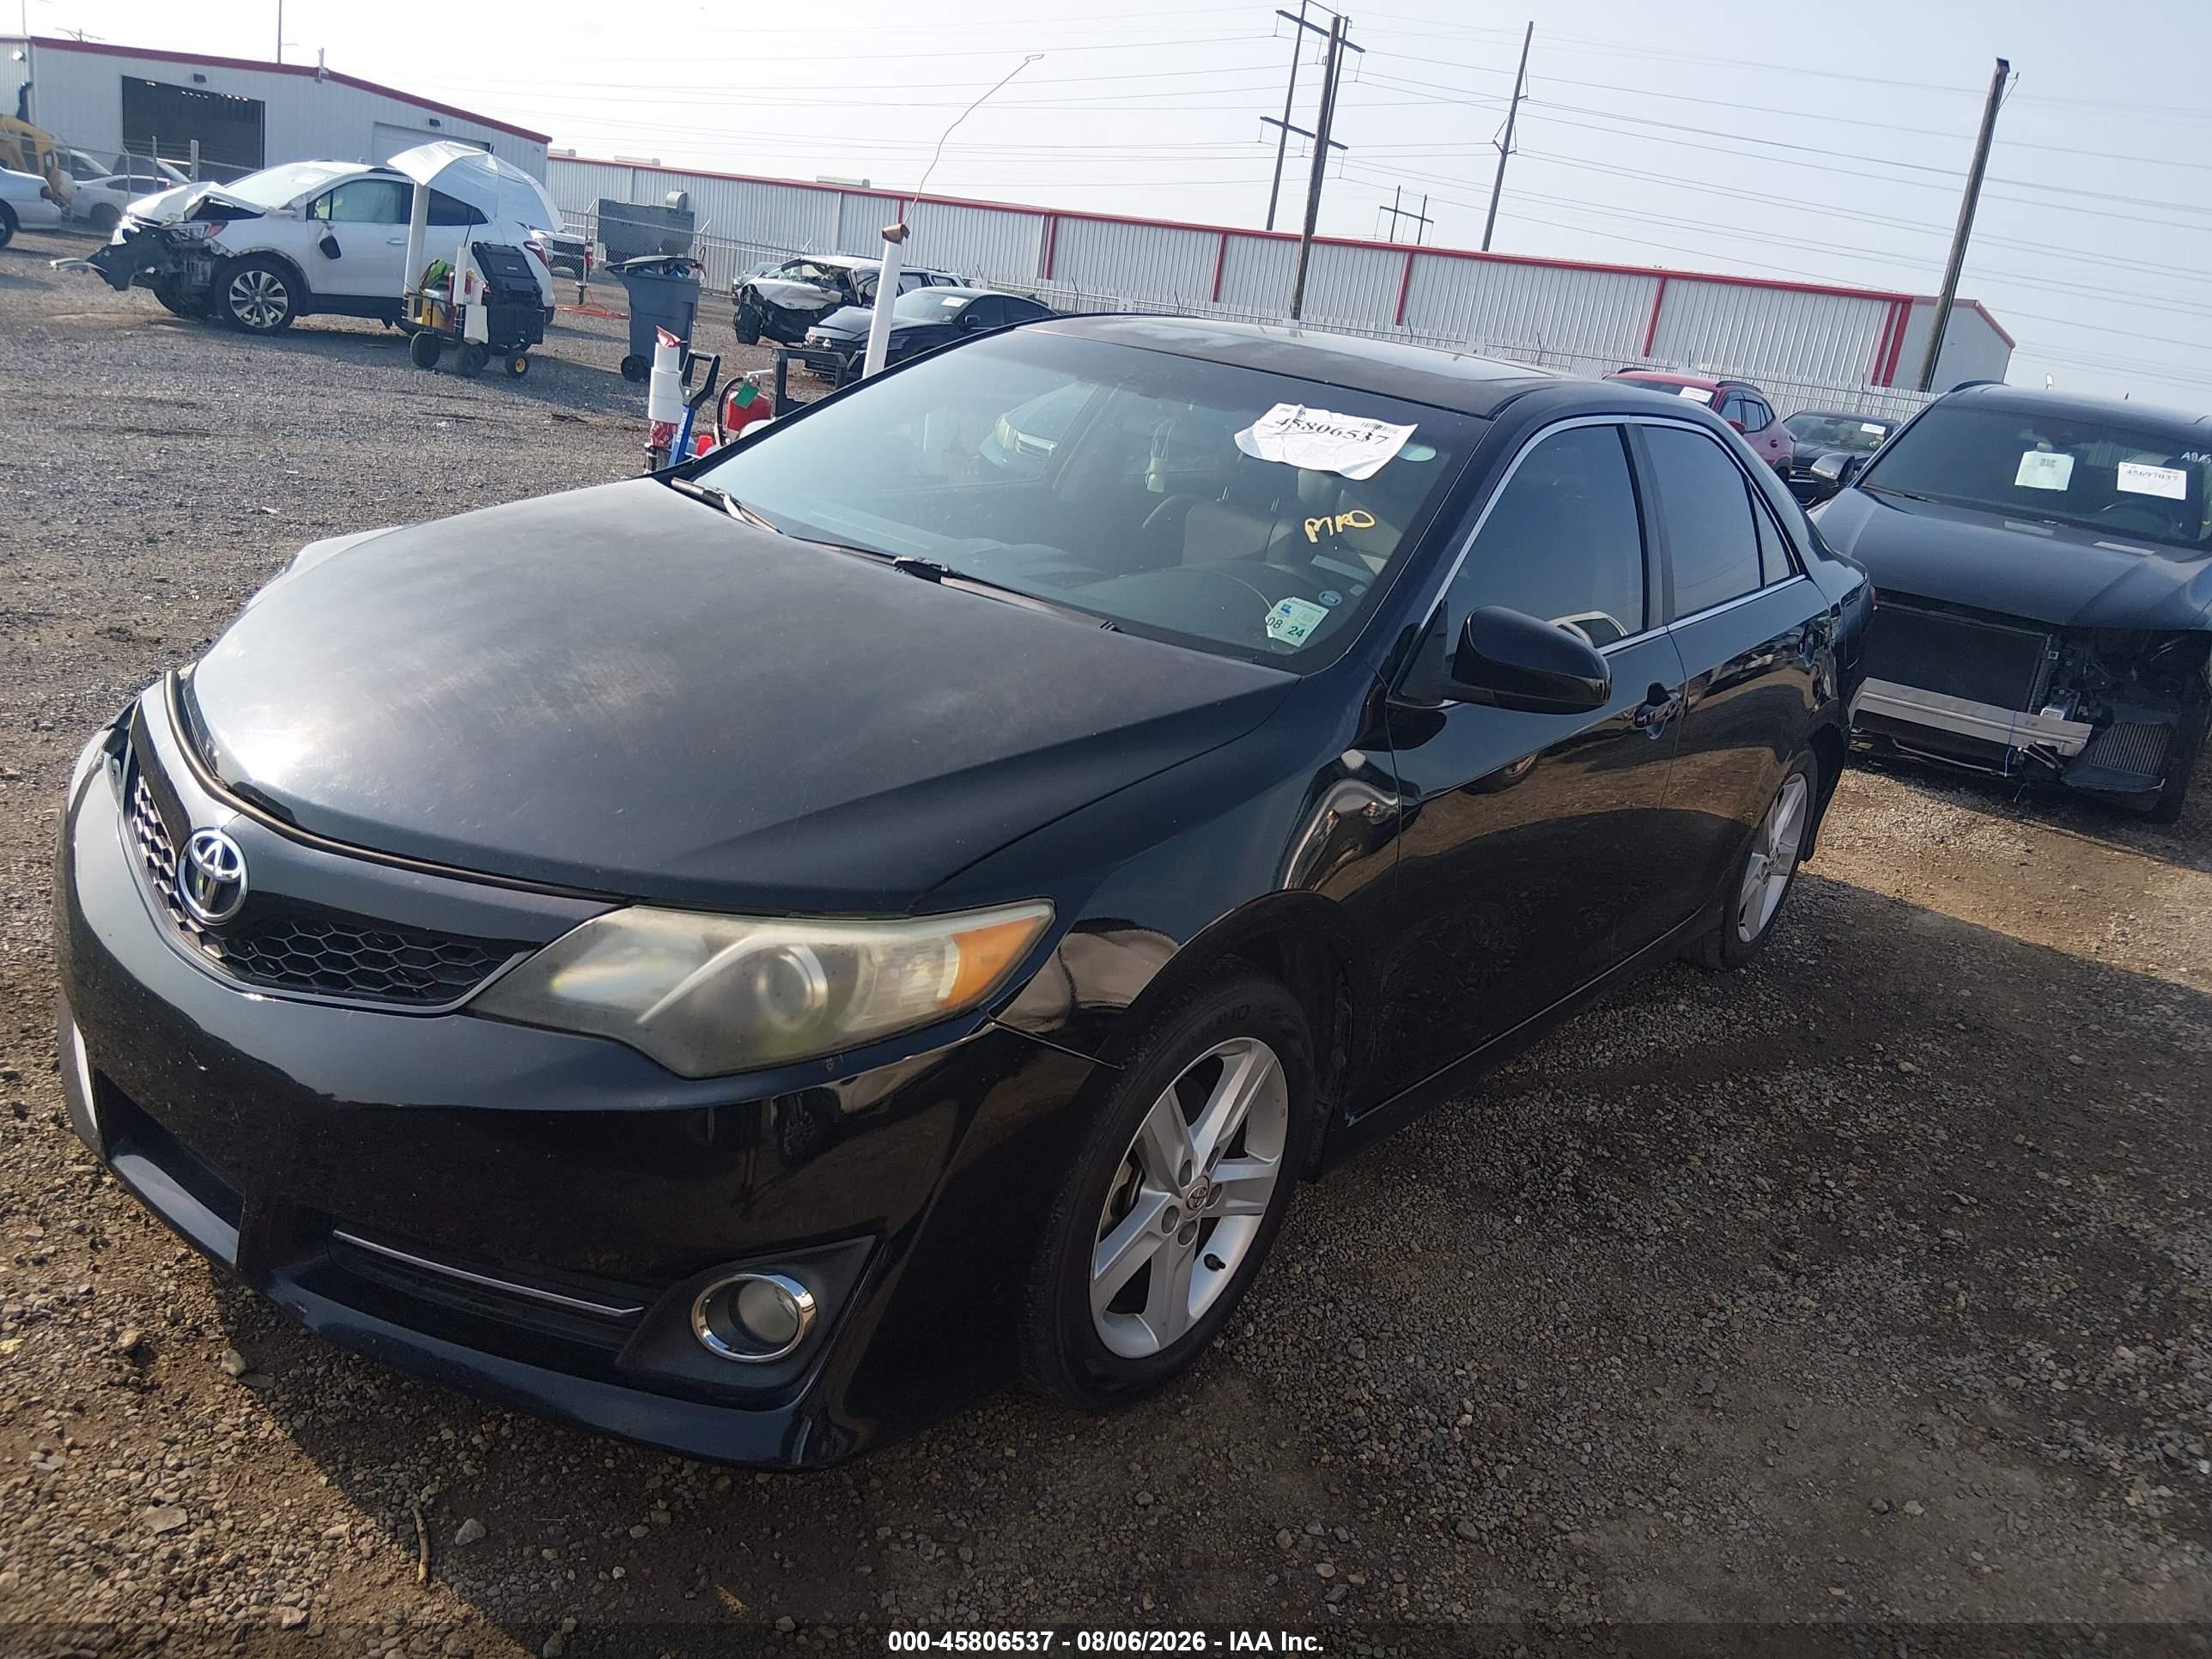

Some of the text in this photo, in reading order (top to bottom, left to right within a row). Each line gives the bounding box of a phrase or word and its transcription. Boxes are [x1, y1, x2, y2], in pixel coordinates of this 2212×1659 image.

[1275, 417, 1390, 445] 45806537
[1267, 617, 1305, 638] 08 24
